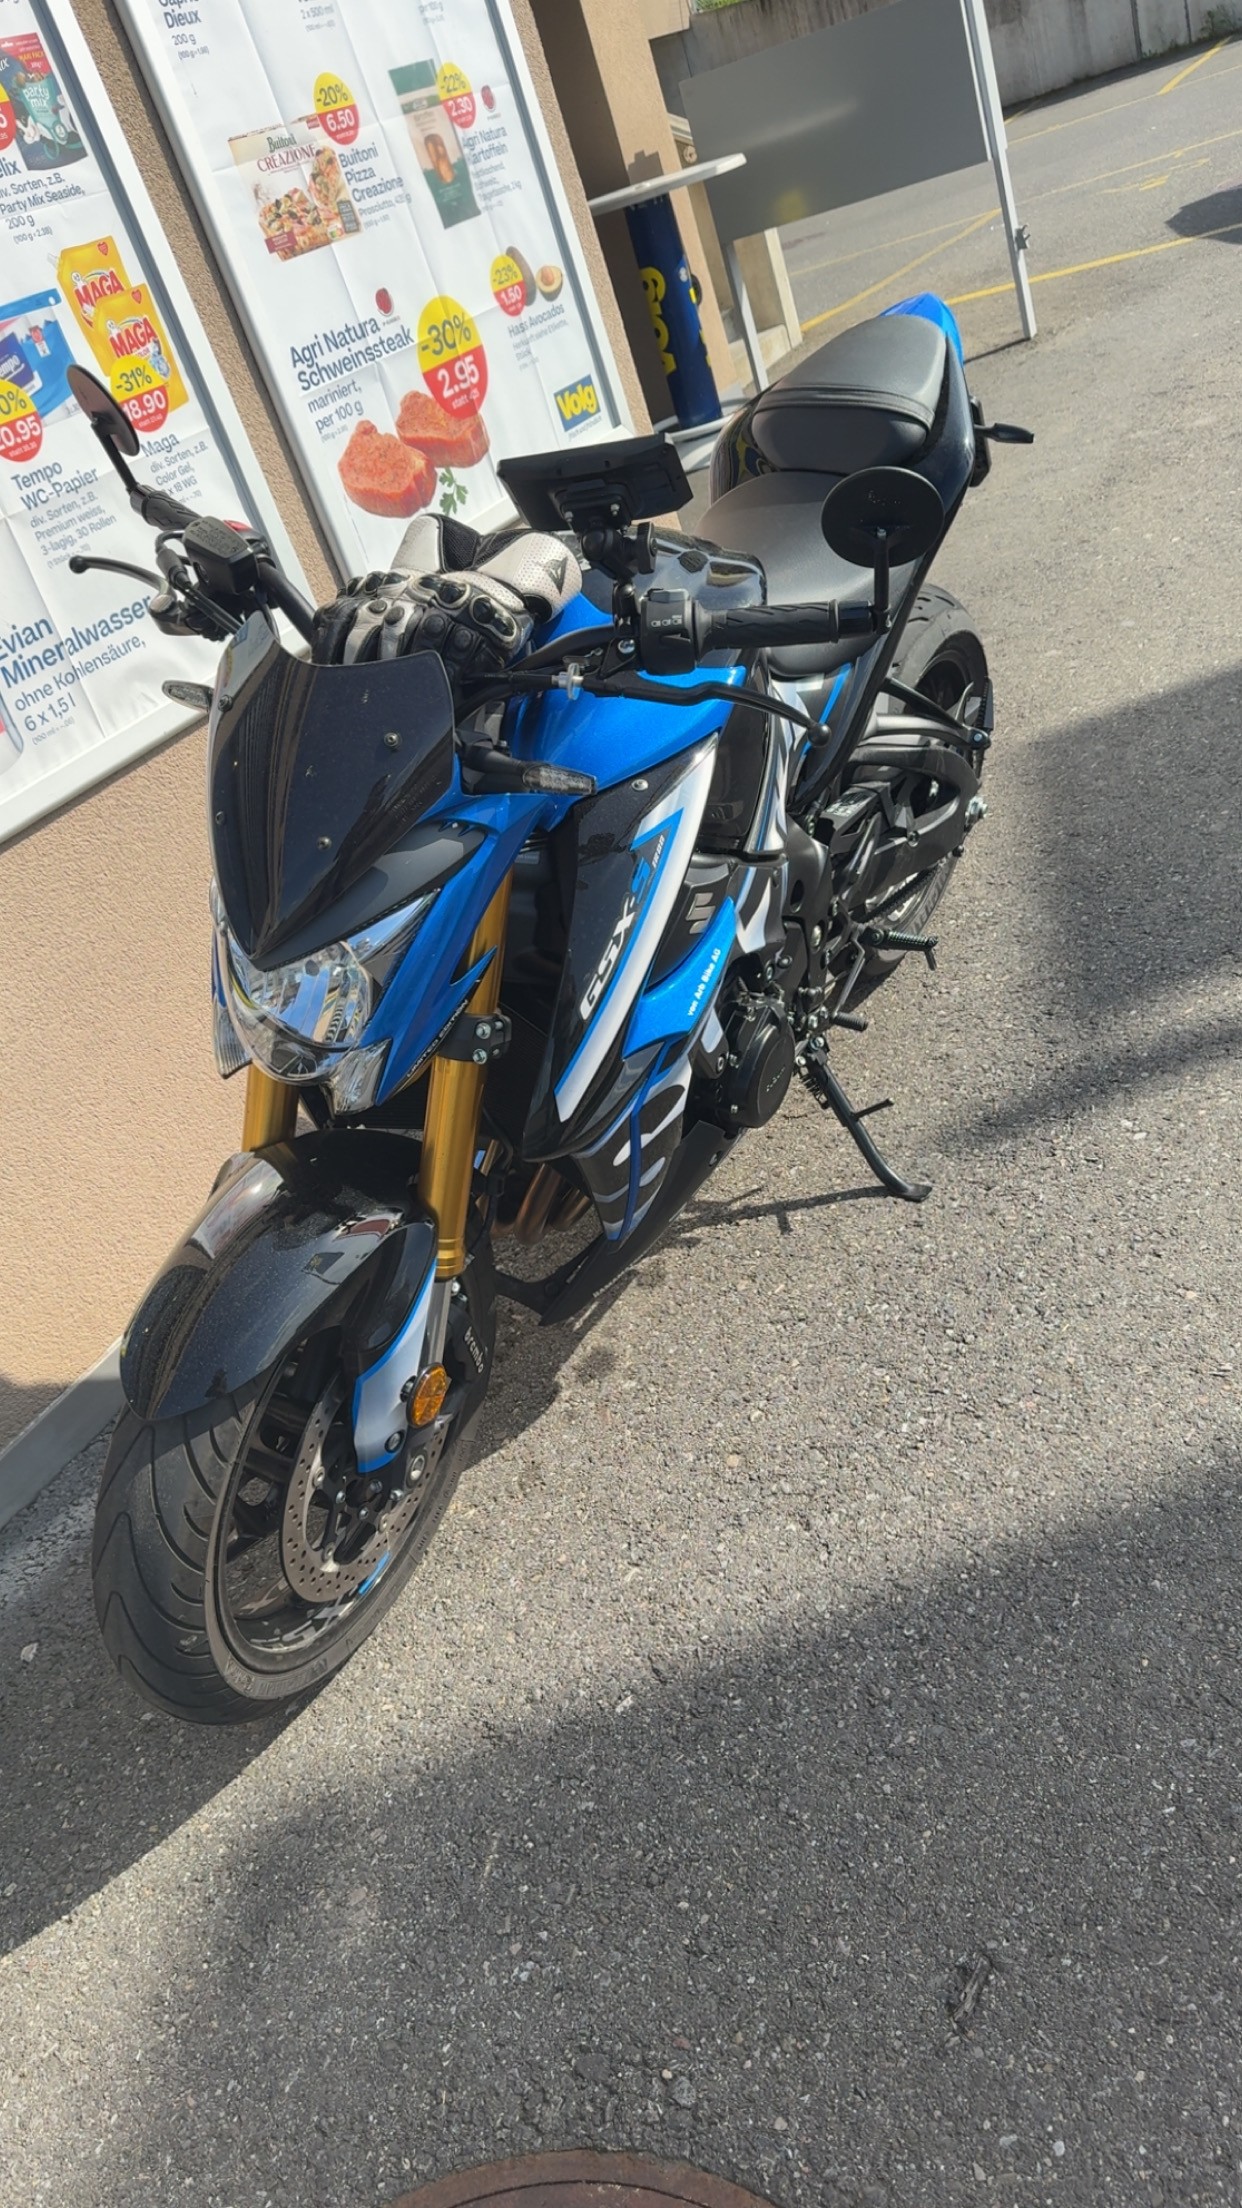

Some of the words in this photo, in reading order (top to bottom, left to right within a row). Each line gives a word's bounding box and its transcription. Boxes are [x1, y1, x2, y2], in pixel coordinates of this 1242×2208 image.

[164, 10, 202, 29] Dieux
[315, 84, 349, 106] -20%
[326, 109, 355, 132] 6.50
[339, 142, 379, 168] Buitoni
[10, 179, 48, 195] Sorten,
[47, 173, 65, 185] z.B.
[345, 165, 376, 185] Pizza
[352, 176, 404, 202] Creazione
[28, 194, 45, 207] Mix
[45, 184, 86, 202] Seaside,
[6, 216, 25, 230] 200
[74, 271, 124, 309] MAGA
[110, 317, 157, 358] MAGA
[290, 334, 322, 370] Agri
[323, 317, 381, 355] Natura
[421, 313, 473, 356] -30%
[297, 325, 415, 392] Schweinssteak
[116, 365, 153, 393] -31%
[436, 355, 481, 398] 2.95
[122, 390, 166, 421] 18.90
[307, 378, 363, 414] mariniert,
[556, 383, 597, 420] Volg
[315, 413, 336, 434] per
[335, 405, 356, 425] 100
[354, 399, 364, 419] g
[141, 433, 180, 458] Maga
[150, 459, 166, 474] div.
[166, 448, 195, 469] Sorten,
[193, 441, 208, 456] z.B.
[11, 461, 63, 492] Tempo
[20, 467, 99, 511] WC-Papier
[155, 468, 178, 487] Color
[178, 461, 196, 479] Gel,
[182, 475, 197, 491] WG
[30, 512, 47, 529] div.
[48, 497, 80, 521] Sorten,
[81, 491, 98, 508] z.B.
[35, 518, 77, 542] Premium
[40, 530, 75, 556] 3-lagig,
[75, 524, 89, 540] 30
[90, 514, 117, 535] Rollen
[14, 682, 53, 712] ohne
[54, 634, 147, 693] Kohlensäure,
[24, 716, 37, 733] 6
[40, 711, 50, 724] x
[47, 699, 71, 721] 1,5
[688, 1002, 700, 1016] von
[694, 980, 706, 1000] Arb
[701, 962, 716, 983] Bike
[711, 948, 722, 963] AG
[464, 1326, 484, 1374] brembo
